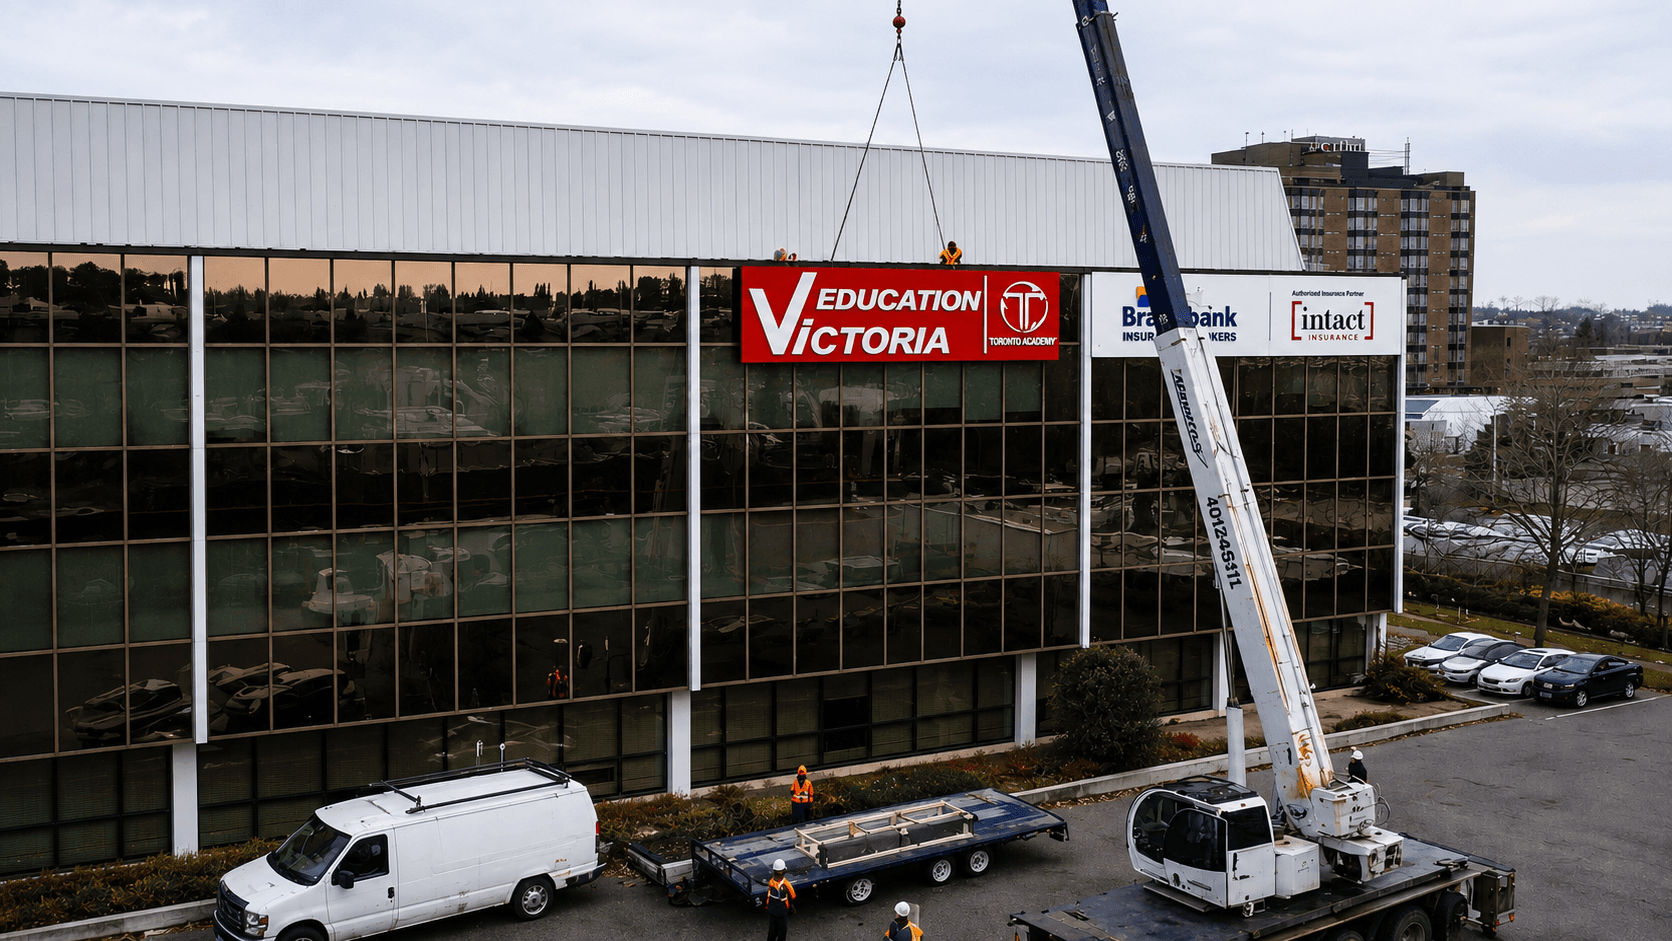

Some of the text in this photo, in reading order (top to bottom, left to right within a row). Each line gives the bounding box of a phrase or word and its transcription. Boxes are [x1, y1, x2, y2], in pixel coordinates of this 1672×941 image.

[815, 288, 982, 311] EDUCATION
[988, 337, 1058, 346] TORONTO ACADEMY
